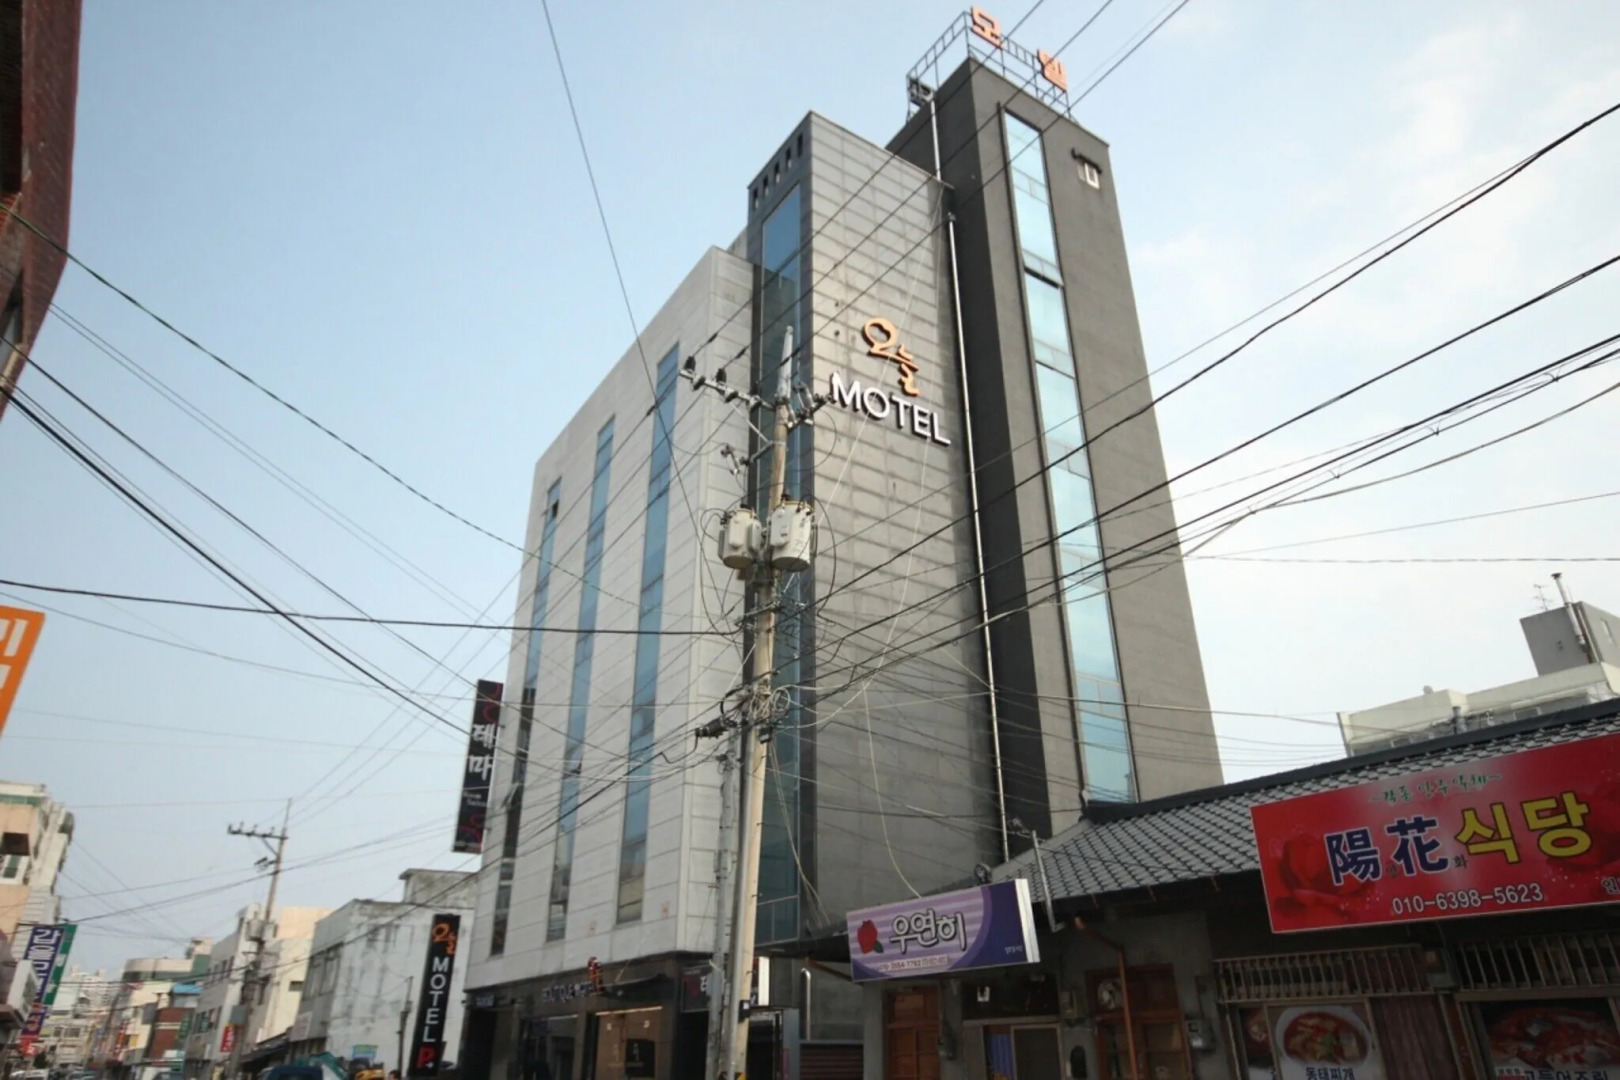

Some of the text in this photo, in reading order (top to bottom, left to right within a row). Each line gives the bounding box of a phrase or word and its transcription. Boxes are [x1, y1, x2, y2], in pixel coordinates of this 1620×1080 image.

[861, 317, 920, 397] 오늘
[829, 371, 951, 446] MOTEL
[1324, 816, 1449, 886] 陽花
[1455, 791, 1592, 864] 식당
[1452, 854, 1468, 869] 화
[1392, 882, 1544, 915] 010-6398-5623
[432, 922, 457, 955] 오늘
[889, 908, 967, 954] 우연히
[422, 957, 450, 1042] MOTEL
[416, 1045, 436, 1069] P
